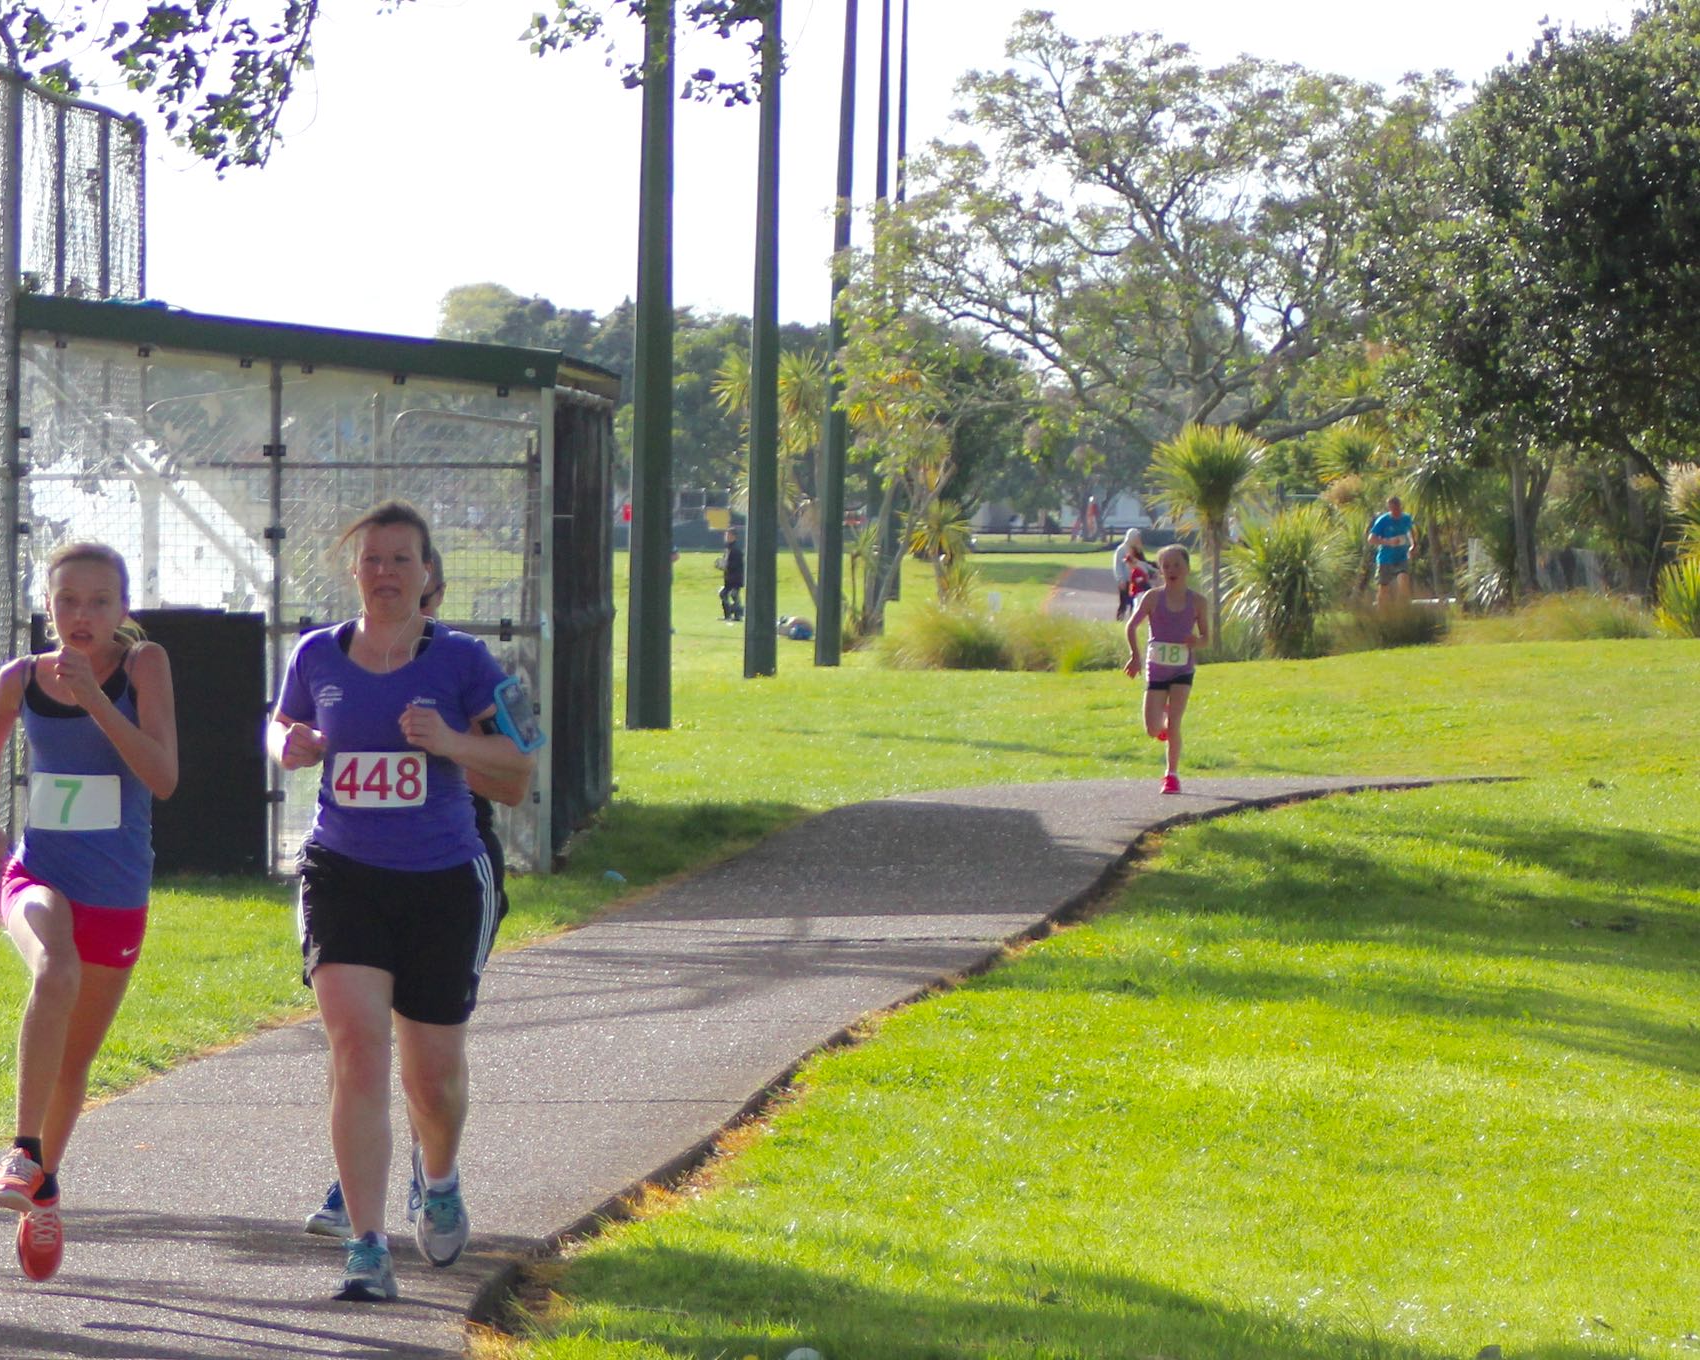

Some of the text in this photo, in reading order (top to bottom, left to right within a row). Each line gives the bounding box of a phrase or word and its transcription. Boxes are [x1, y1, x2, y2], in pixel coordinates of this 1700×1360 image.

[1157, 644, 1180, 664] 18
[334, 756, 422, 801] 448
[54, 779, 83, 824] 7
